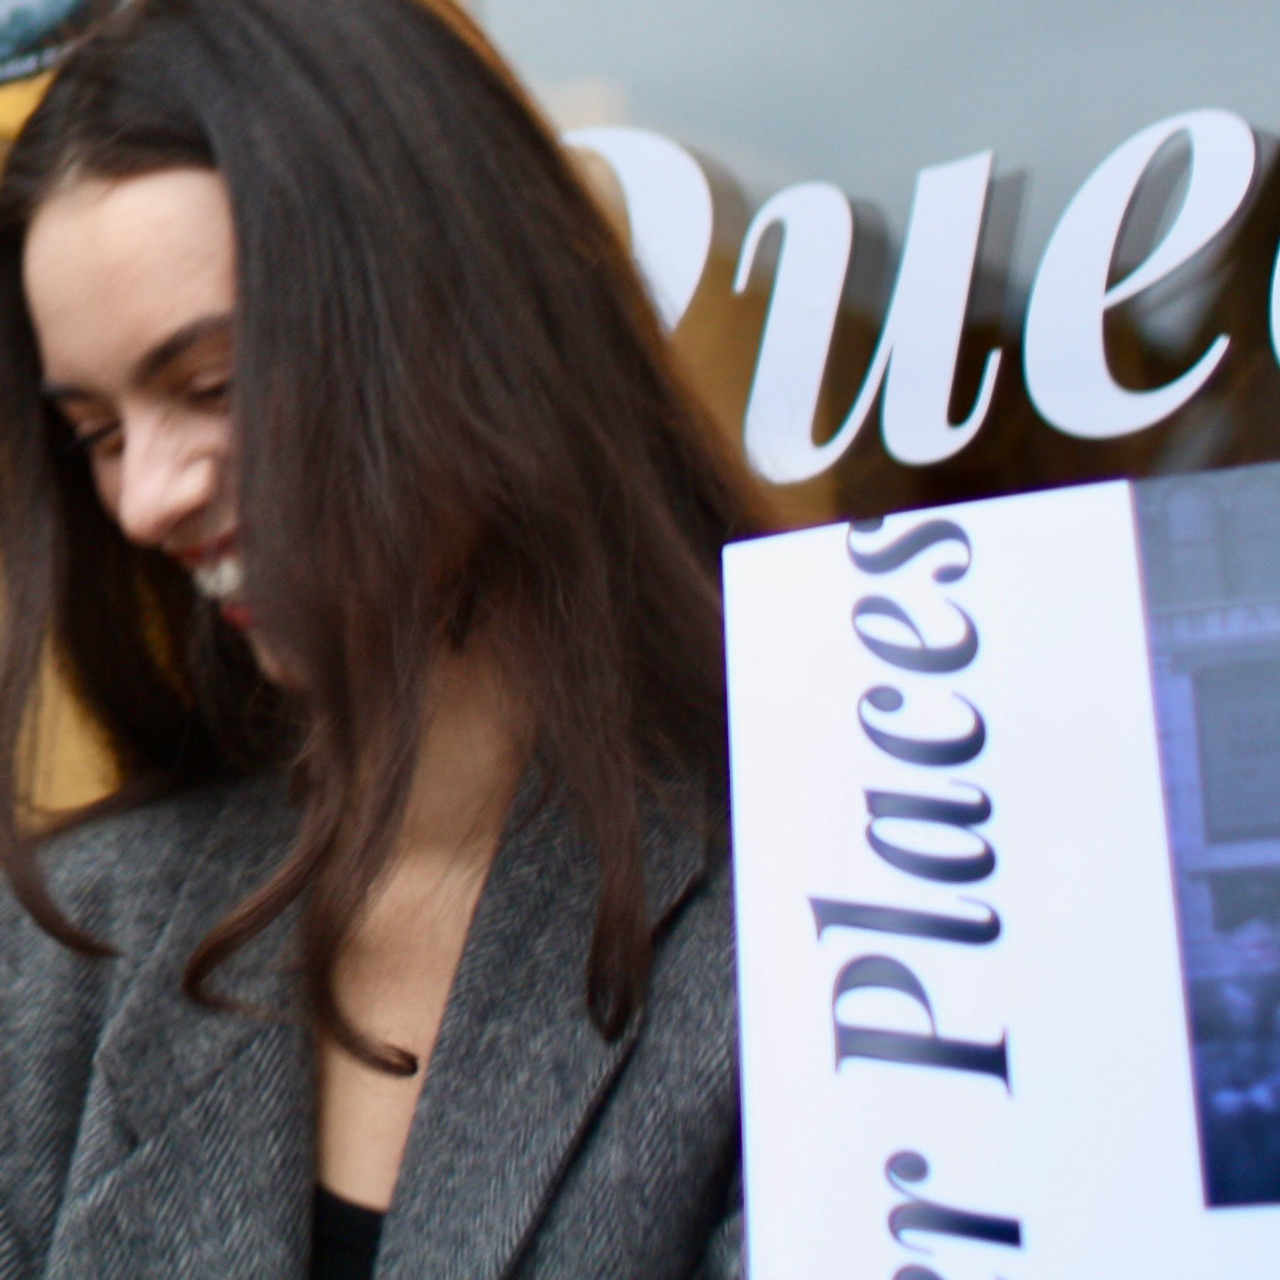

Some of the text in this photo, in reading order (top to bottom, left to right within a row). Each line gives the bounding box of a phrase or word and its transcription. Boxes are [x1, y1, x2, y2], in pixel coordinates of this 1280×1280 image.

[558, 108, 1280, 486] ue
[806, 516, 1023, 1280] r Places
